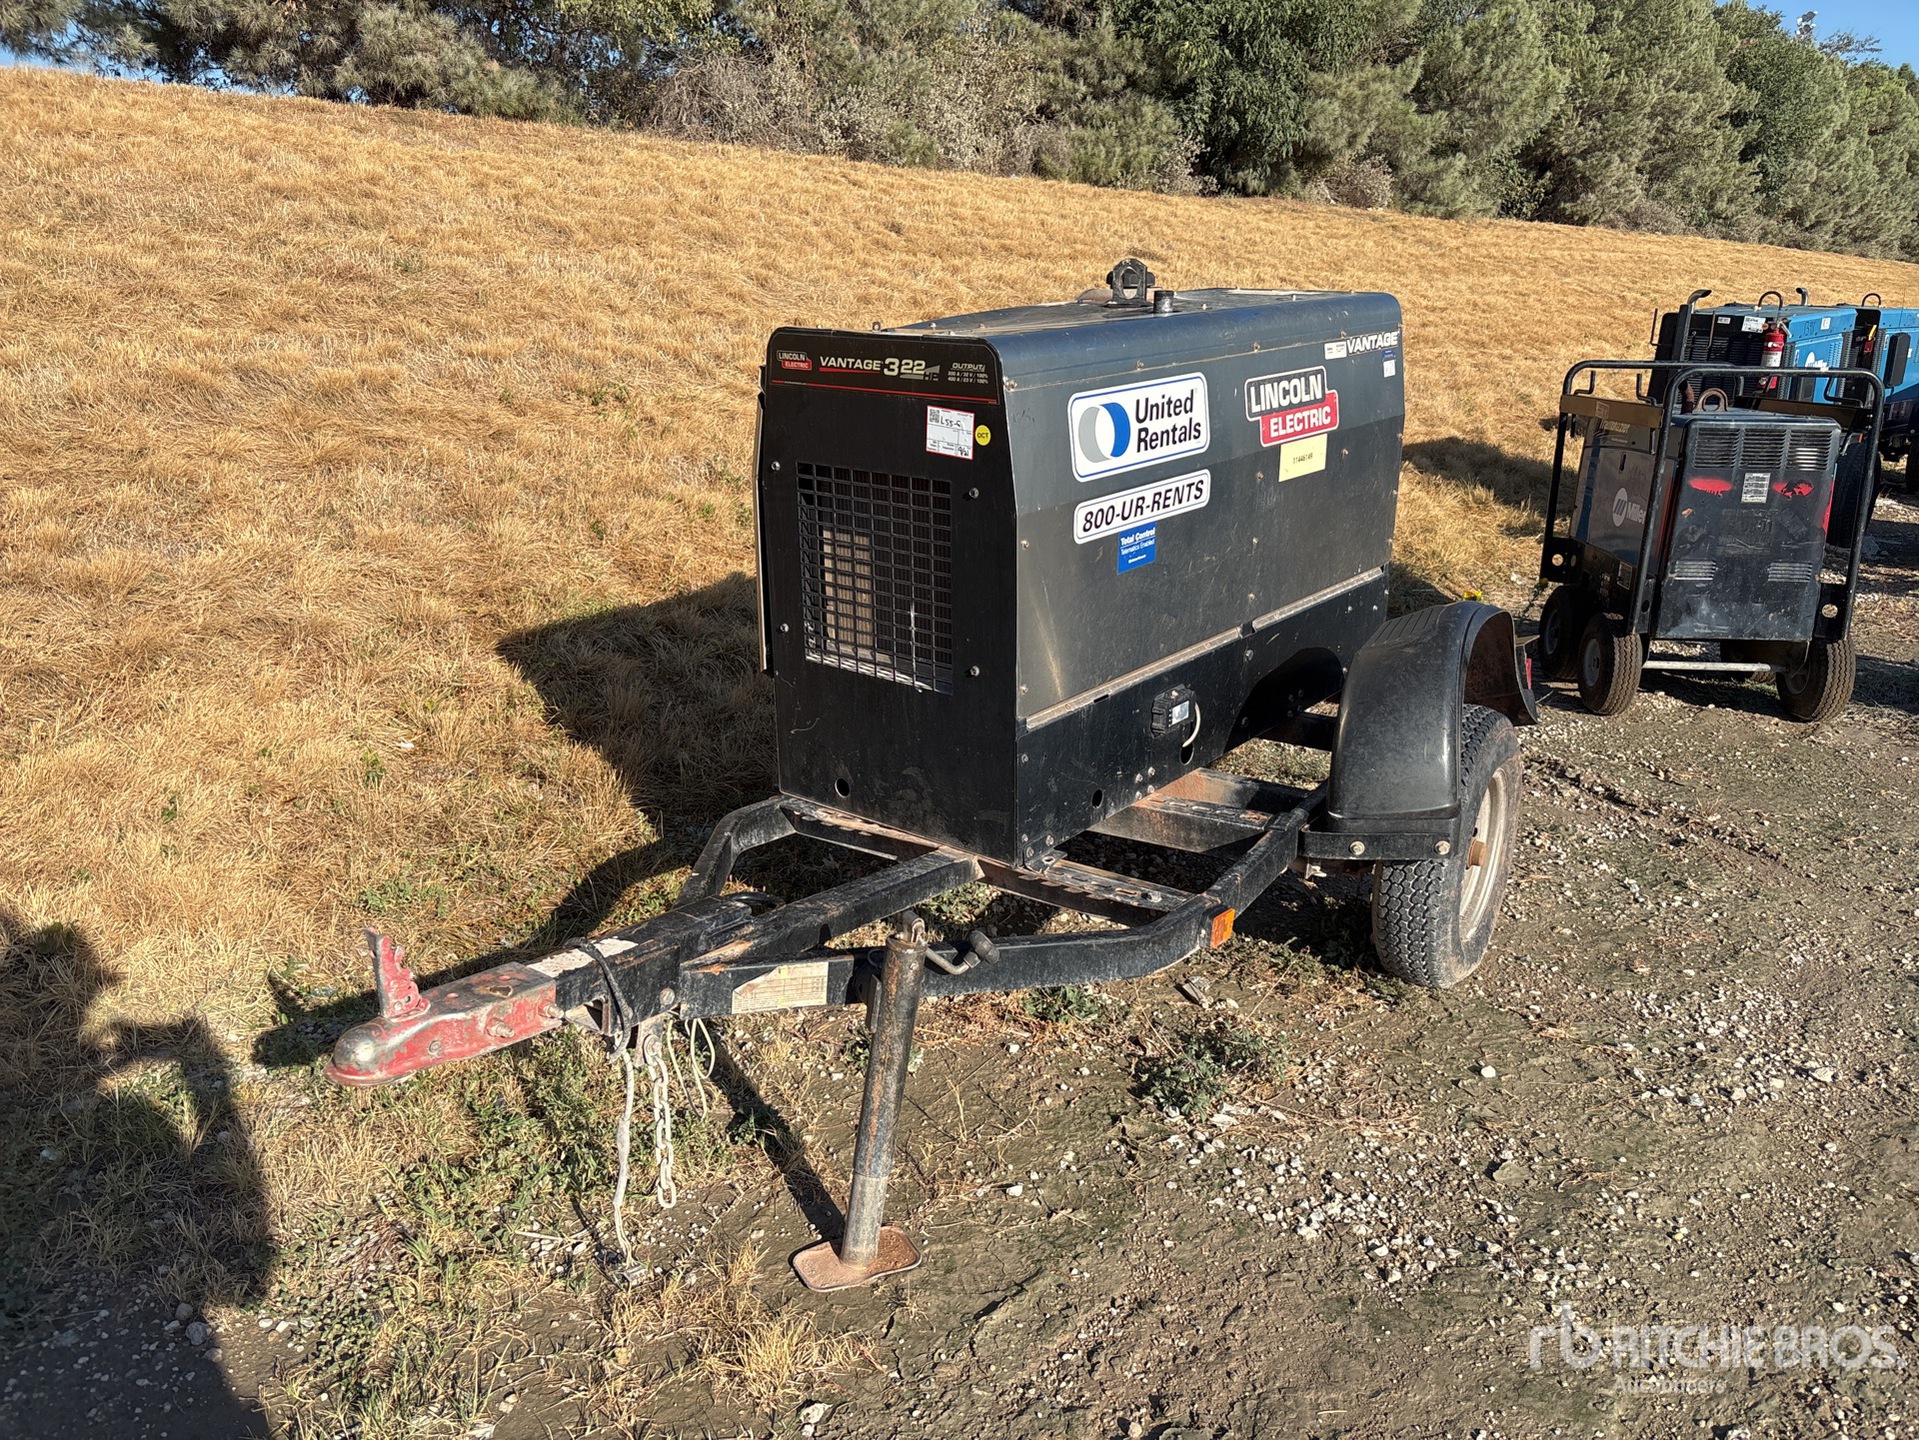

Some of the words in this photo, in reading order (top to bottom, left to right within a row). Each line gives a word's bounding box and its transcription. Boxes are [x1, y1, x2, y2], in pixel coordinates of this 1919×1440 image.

[1347, 331, 1399, 354] VANTAGE
[778, 352, 806, 362] LINCOLN
[784, 360, 809, 369] ELECTRIC
[819, 355, 881, 371] VANTAGE
[883, 357, 926, 377] 322
[1135, 389, 1194, 424] United
[1250, 373, 1323, 414] LINCOLN
[1136, 417, 1201, 453] Rentals
[1269, 405, 1332, 439] ELECTRIC
[1082, 479, 1204, 533] 800-UR-RENTS
[1120, 534, 1135, 546] Total
[1135, 526, 1156, 542] Control
